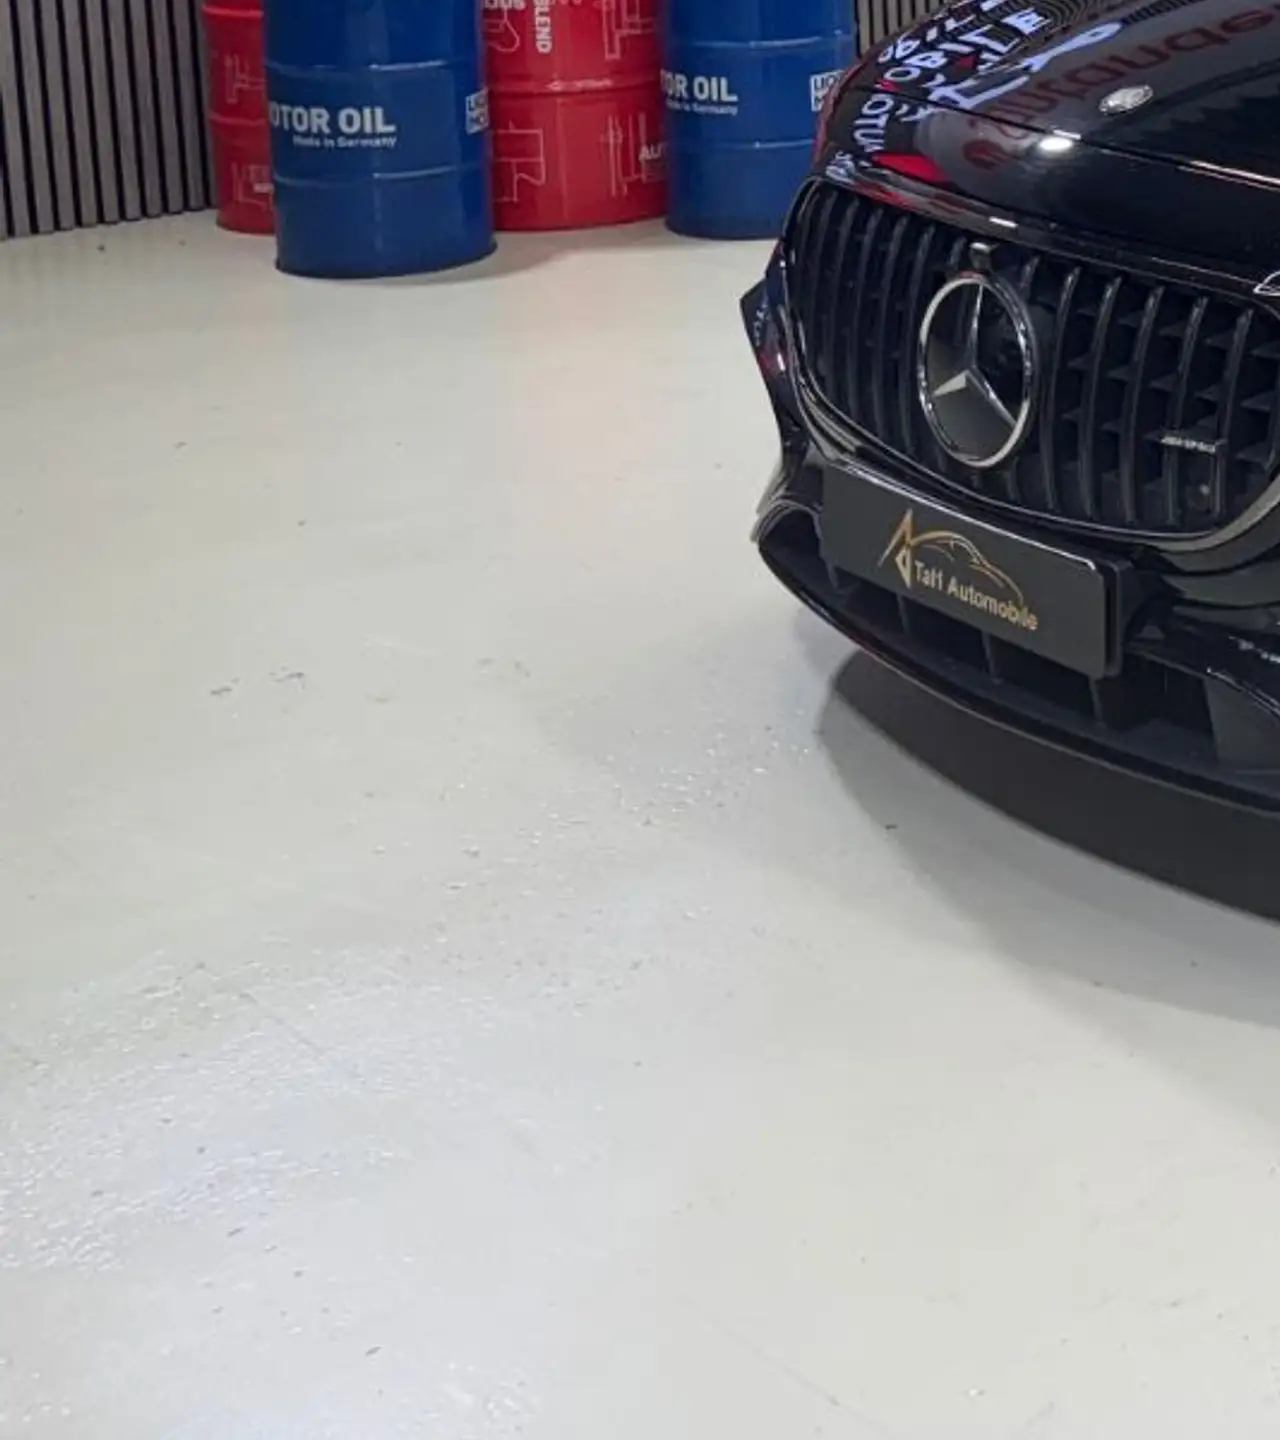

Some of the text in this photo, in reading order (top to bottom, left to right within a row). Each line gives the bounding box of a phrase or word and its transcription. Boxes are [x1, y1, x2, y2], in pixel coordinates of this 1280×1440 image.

[693, 76, 740, 102] OIL
[338, 106, 397, 135] OIL
[946, 577, 1039, 631] Automobile
